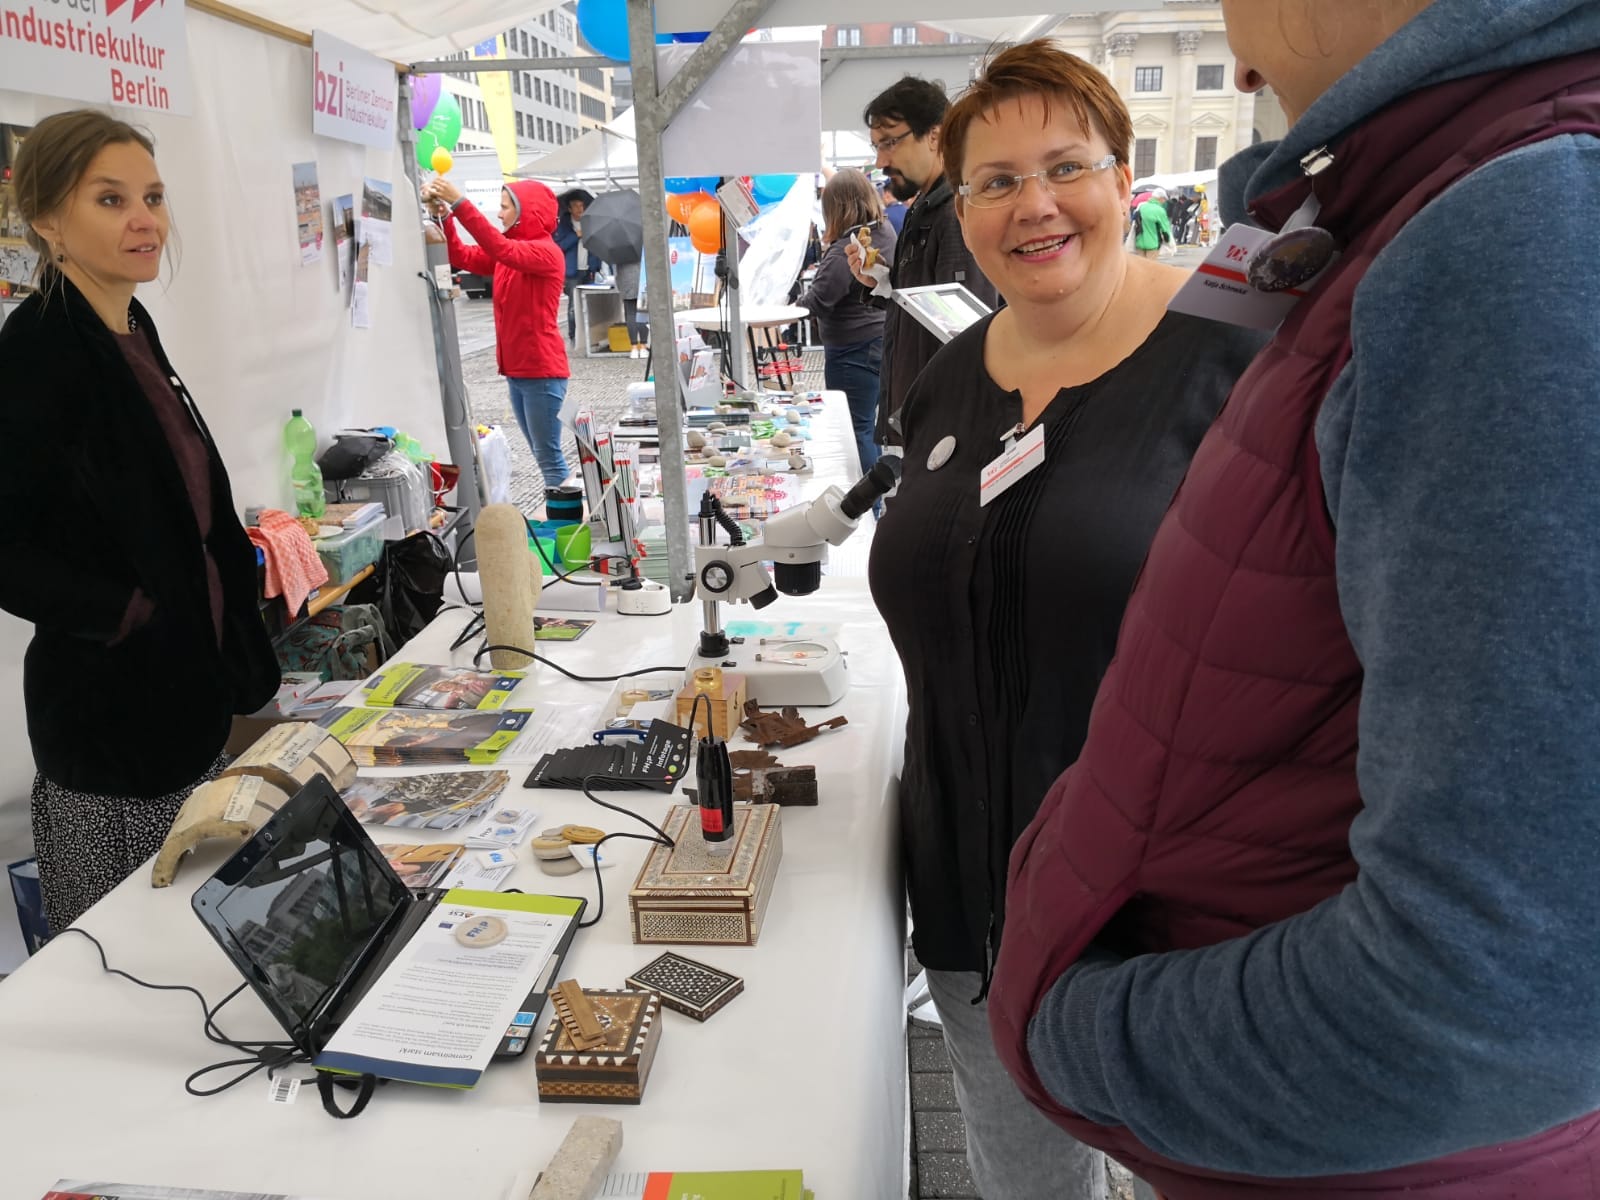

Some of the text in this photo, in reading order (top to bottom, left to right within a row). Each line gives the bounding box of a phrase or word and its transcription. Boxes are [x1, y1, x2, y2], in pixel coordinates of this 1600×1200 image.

[111, 68, 169, 109] Berlin
[315, 51, 343, 118] bzi
[346, 80, 393, 112] Berliner Zentrum
[346, 102, 387, 130] Industriekultur
[656, 739, 671, 767] Infotage
[423, 1050, 473, 1060] Gemeinsam
